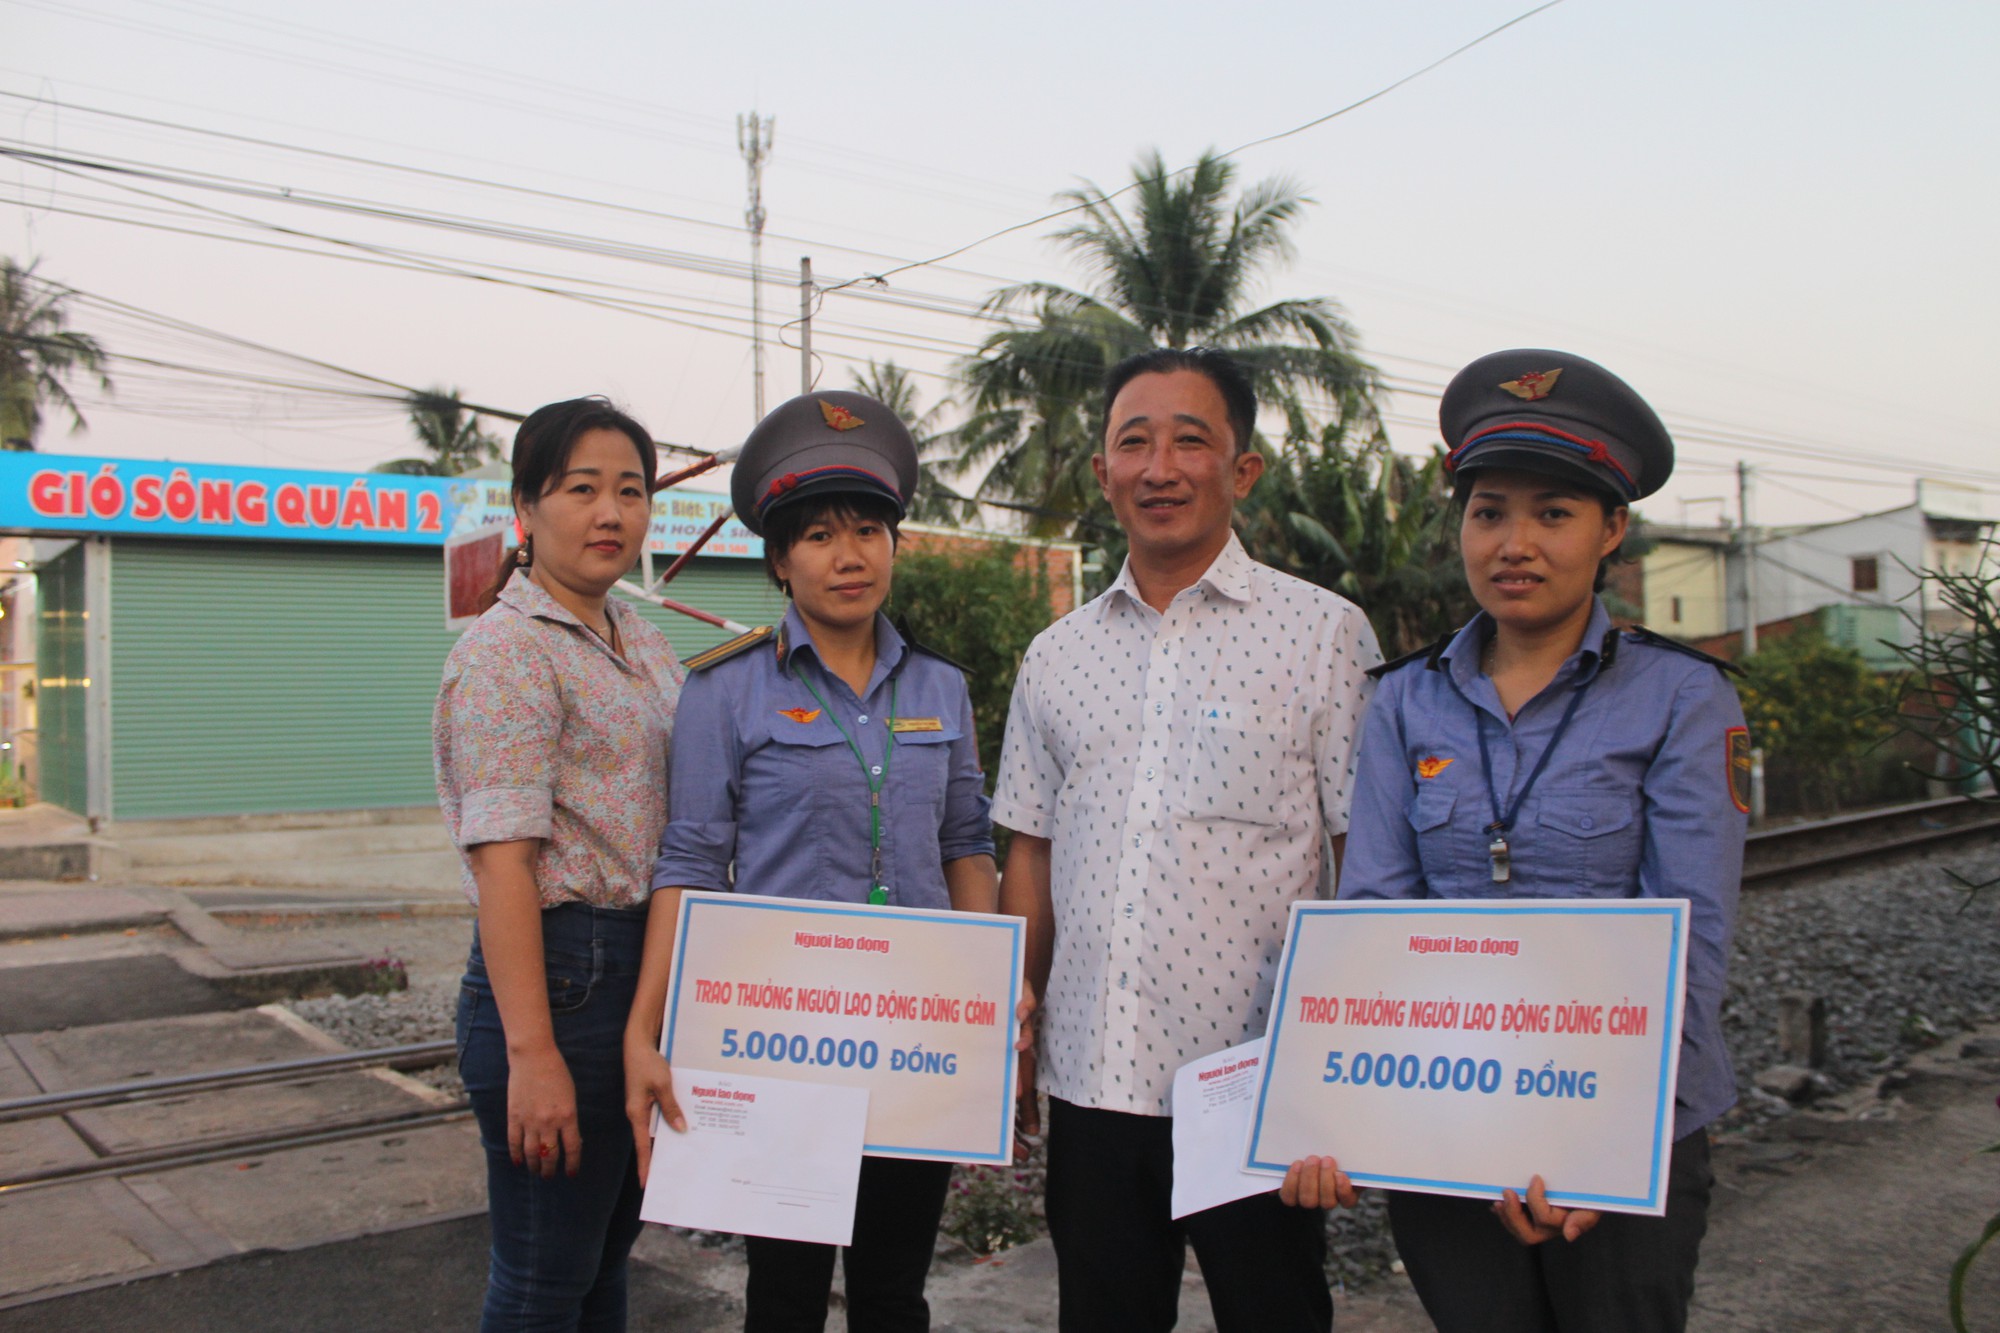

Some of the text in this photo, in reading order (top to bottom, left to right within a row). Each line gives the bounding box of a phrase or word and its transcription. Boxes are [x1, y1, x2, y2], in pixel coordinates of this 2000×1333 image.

[29, 466, 442, 532] GIÓ SÔNG QUÁN 2
[834, 935, 854, 949] lao
[1454, 936, 1478, 953] lao
[695, 978, 996, 1026] TRAO THƯỞNG NGƯỜI LAO ĐỘNG DŨNG CẢM
[1299, 991, 1648, 1039] TRAO THƯỞNG NGƯỜI LAO ĐỘNG DŨNG CẢM
[720, 1028, 879, 1070] 5.000.000
[1322, 1051, 1502, 1094] 5.000.000
